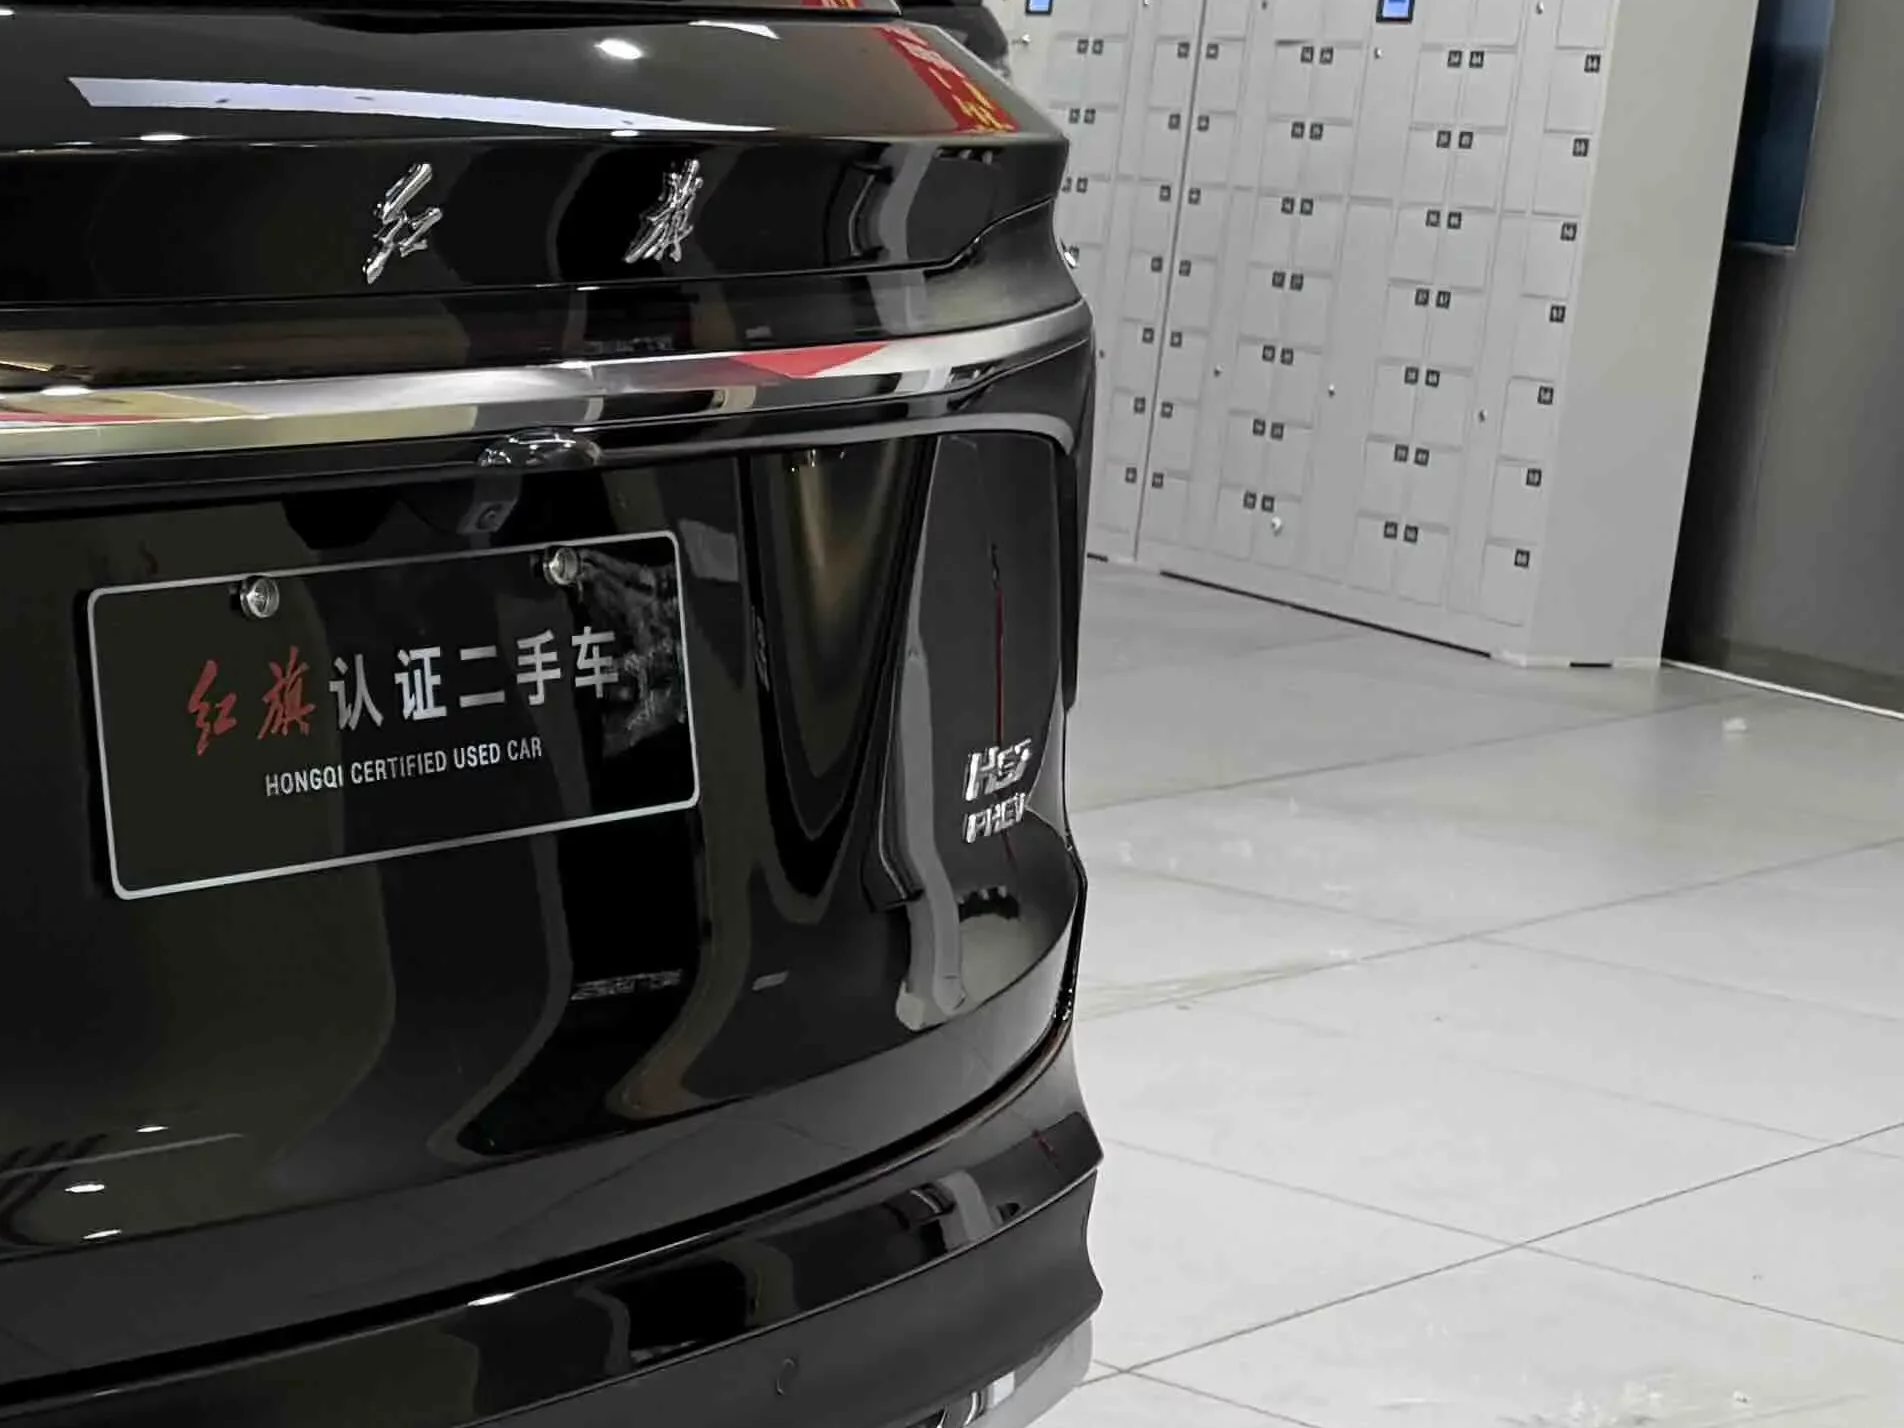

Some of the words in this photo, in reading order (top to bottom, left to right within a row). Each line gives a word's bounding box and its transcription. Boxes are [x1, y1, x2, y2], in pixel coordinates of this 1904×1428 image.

[265, 765, 344, 797] HONGQI
[350, 750, 447, 784] CERTIFIED
[453, 742, 501, 769] USED
[507, 735, 543, 761] CAR
